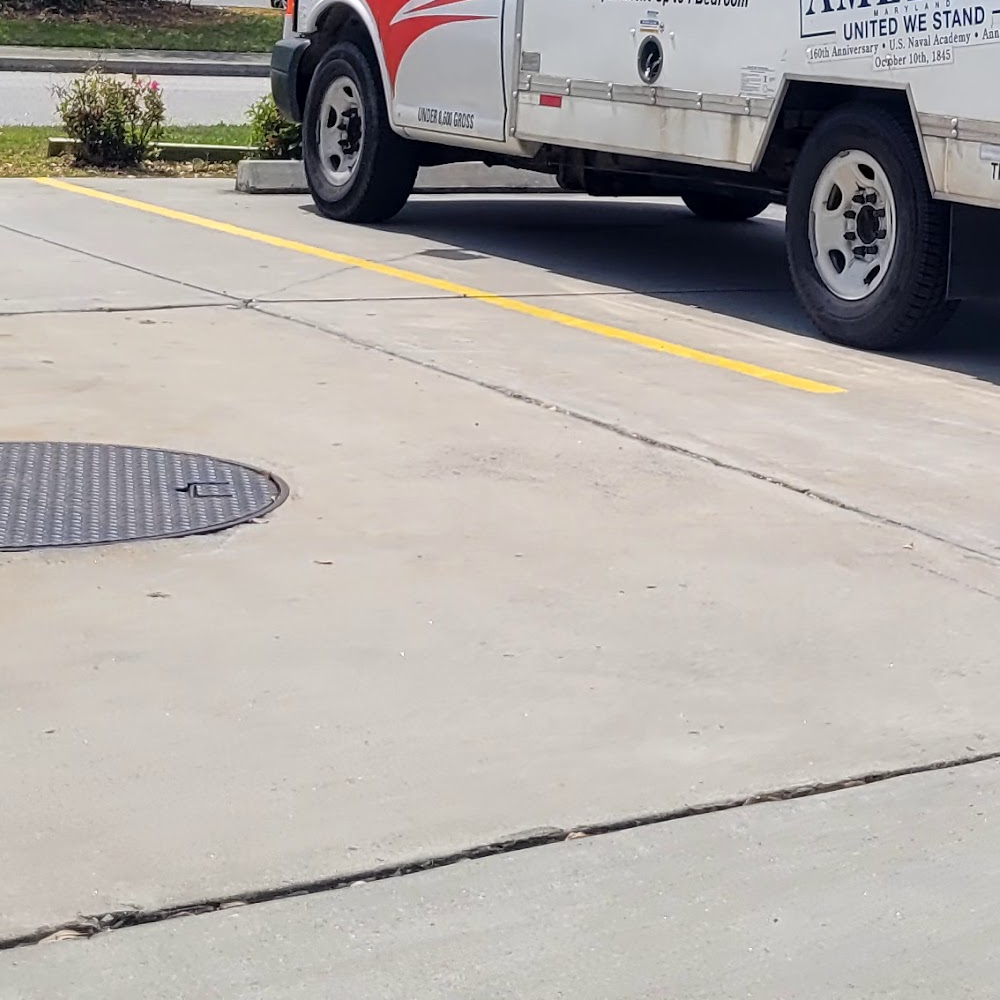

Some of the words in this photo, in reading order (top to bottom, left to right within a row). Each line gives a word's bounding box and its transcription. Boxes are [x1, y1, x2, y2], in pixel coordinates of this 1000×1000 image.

[873, 0, 952, 17] MARYLAND
[843, 16, 898, 41] UNITED
[903, 13, 927, 34] WE
[932, 6, 985, 30] STAND
[809, 46, 830, 61] 160th
[831, 42, 879, 59] Anniversary
[889, 39, 906, 51] U.S.
[908, 35, 931, 49] Naval
[933, 30, 971, 48] Academy
[908, 52, 930, 66] 10th,
[931, 50, 951, 63] 1845
[418, 106, 438, 123] UNDER
[453, 111, 474, 129] GROSS
